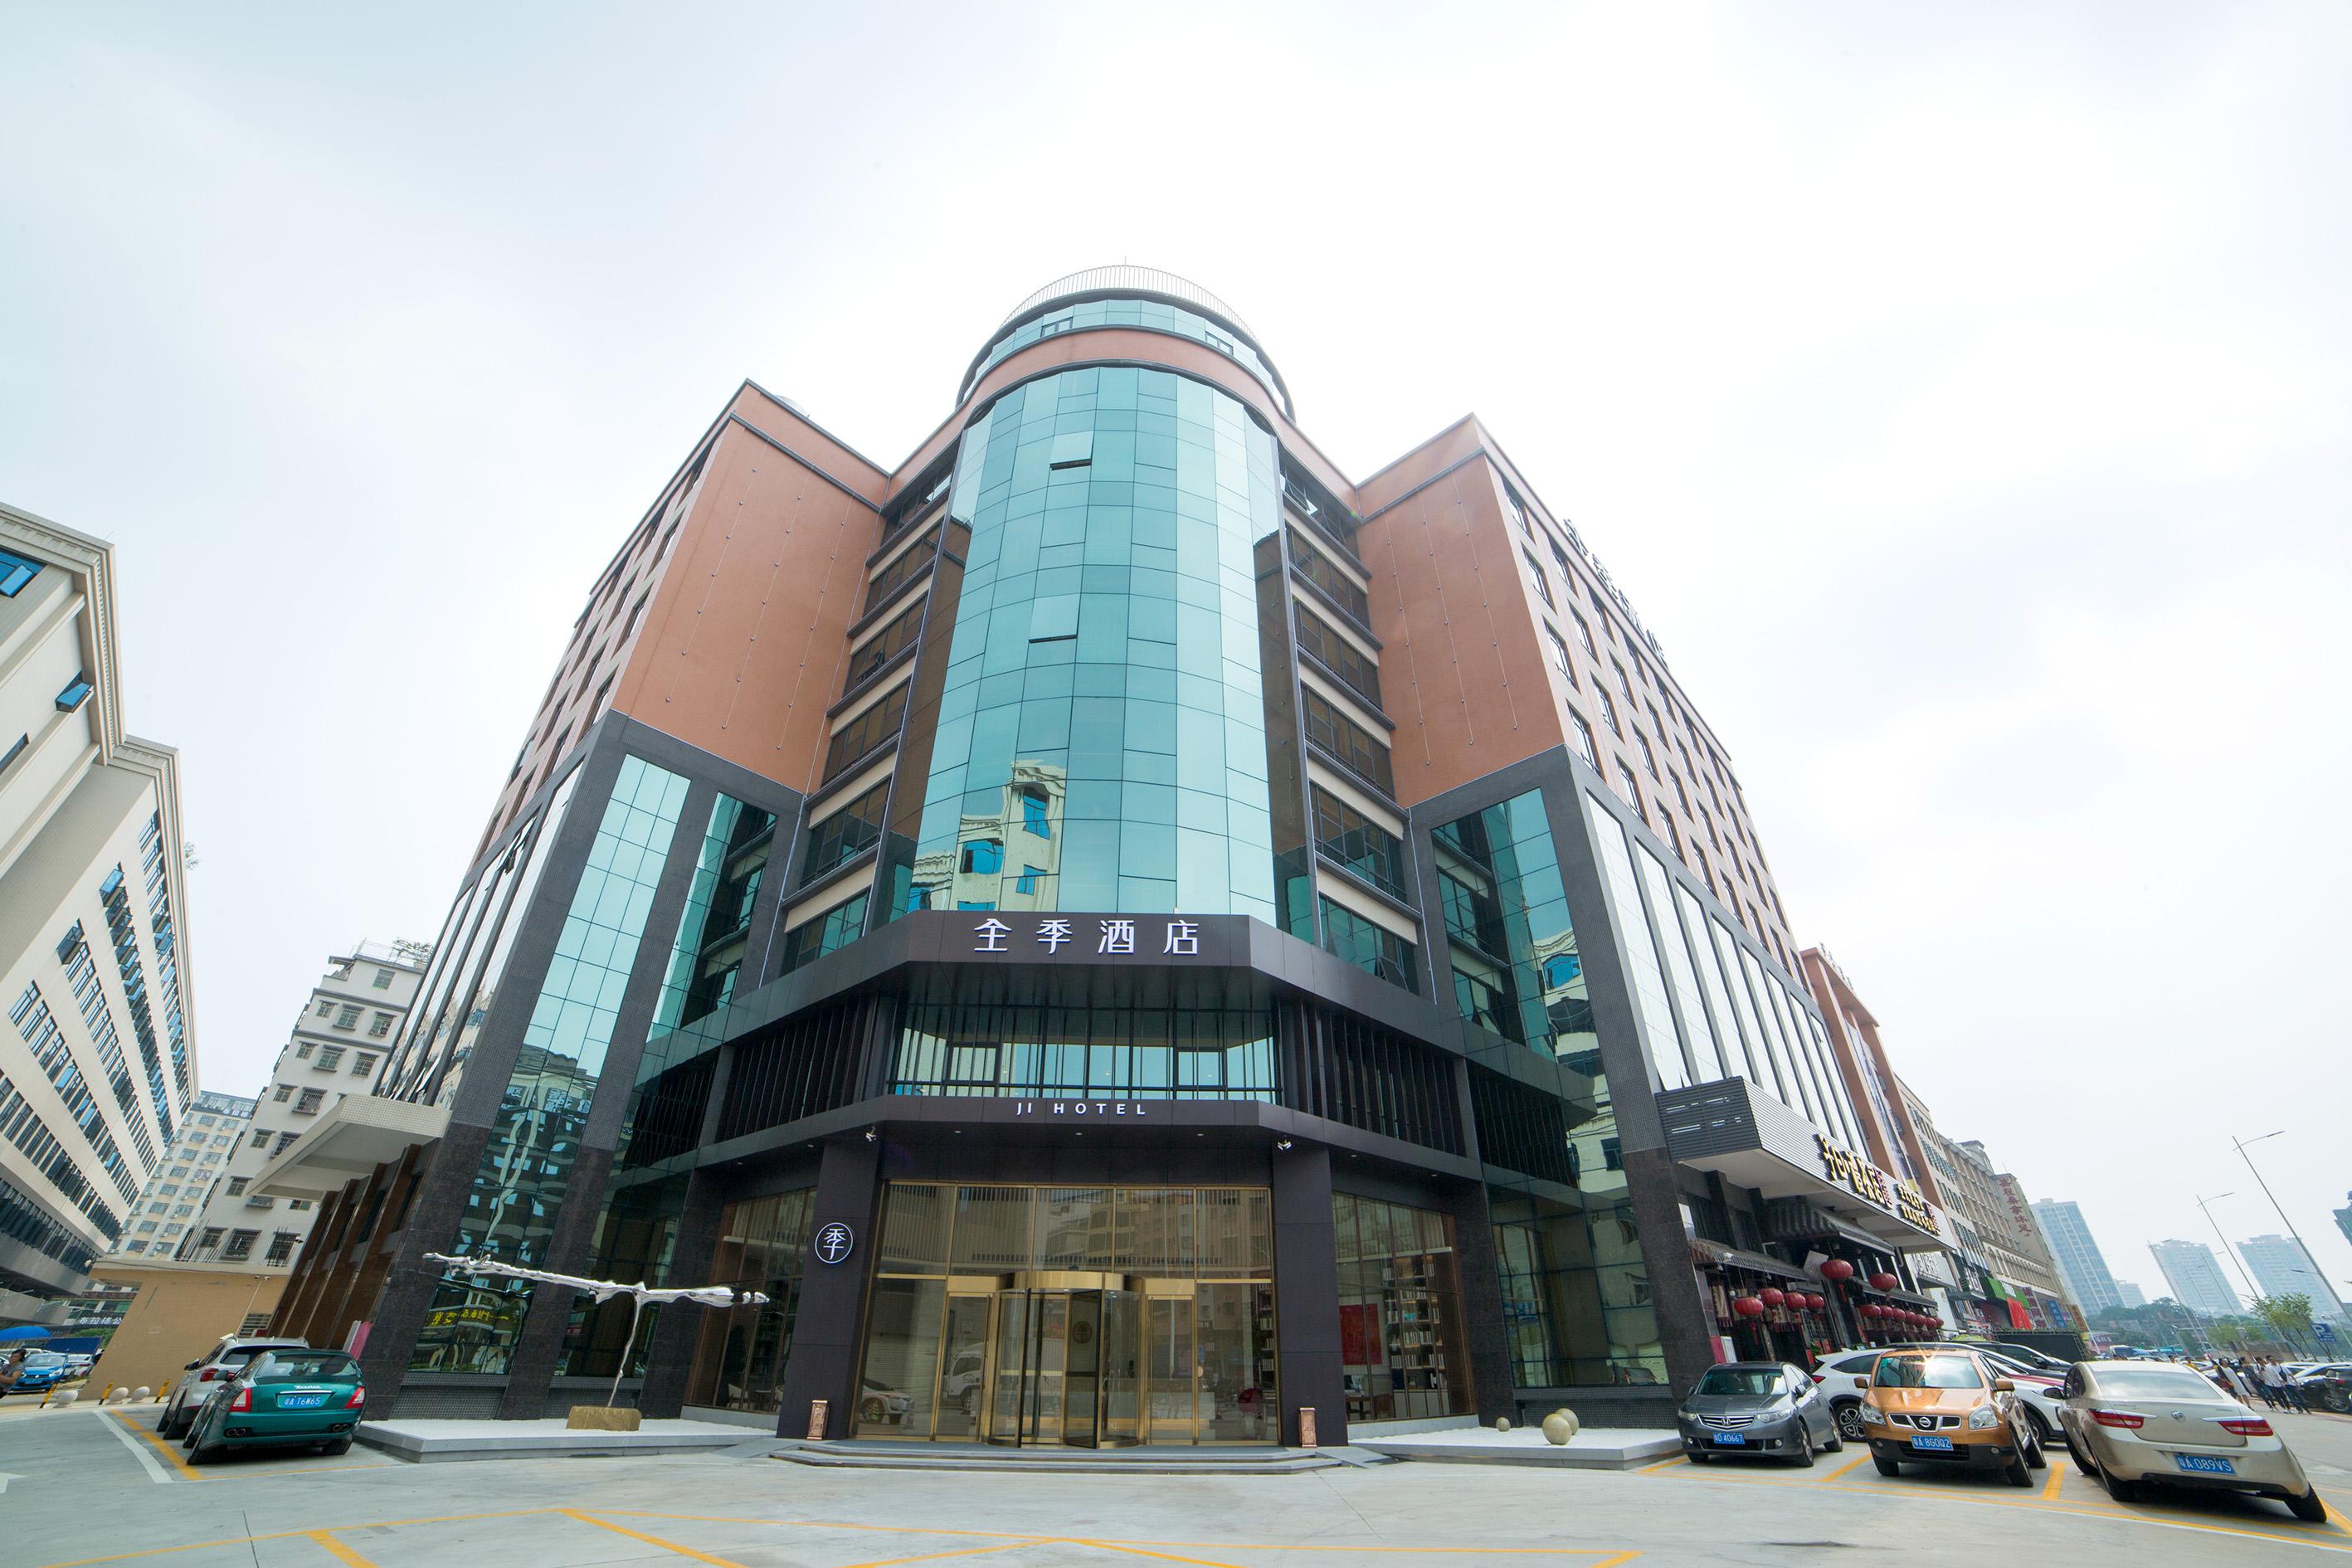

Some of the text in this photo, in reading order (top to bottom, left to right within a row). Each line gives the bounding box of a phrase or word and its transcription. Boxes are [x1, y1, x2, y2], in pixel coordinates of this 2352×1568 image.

[973, 918, 1200, 956] 全季酒店
[1016, 1102, 1146, 1116] JI HOTEL
[823, 1228, 846, 1261] 季
[2311, 1324, 2325, 1337] P
